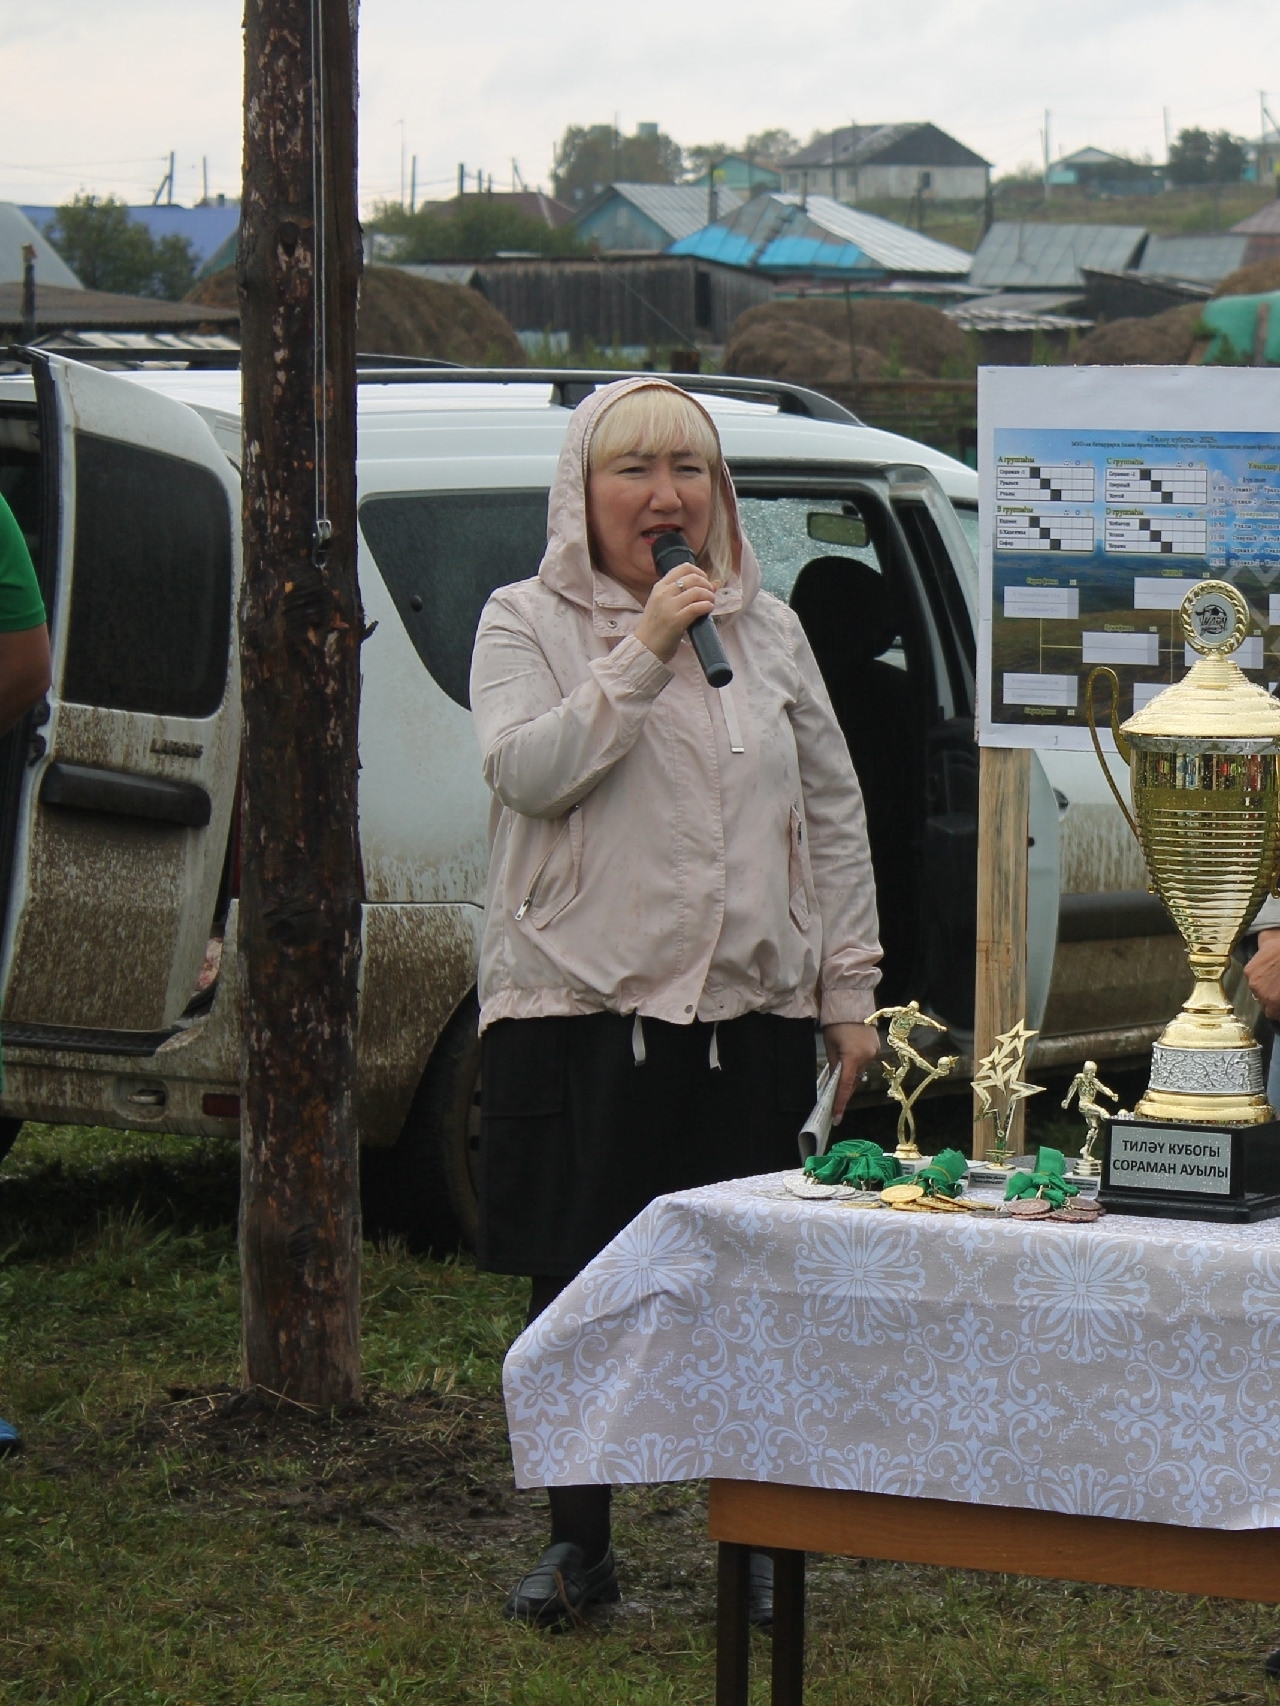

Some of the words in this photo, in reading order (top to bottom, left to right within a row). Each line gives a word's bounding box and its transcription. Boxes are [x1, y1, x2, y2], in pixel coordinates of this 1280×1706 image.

[1122, 1140, 1166, 1154] ТИЛӘҮ
[1168, 1144, 1220, 1158] КУБОГЫ
[1112, 1159, 1176, 1174] СОРАМАН
[1180, 1165, 1228, 1178] АУЫЛЫ
